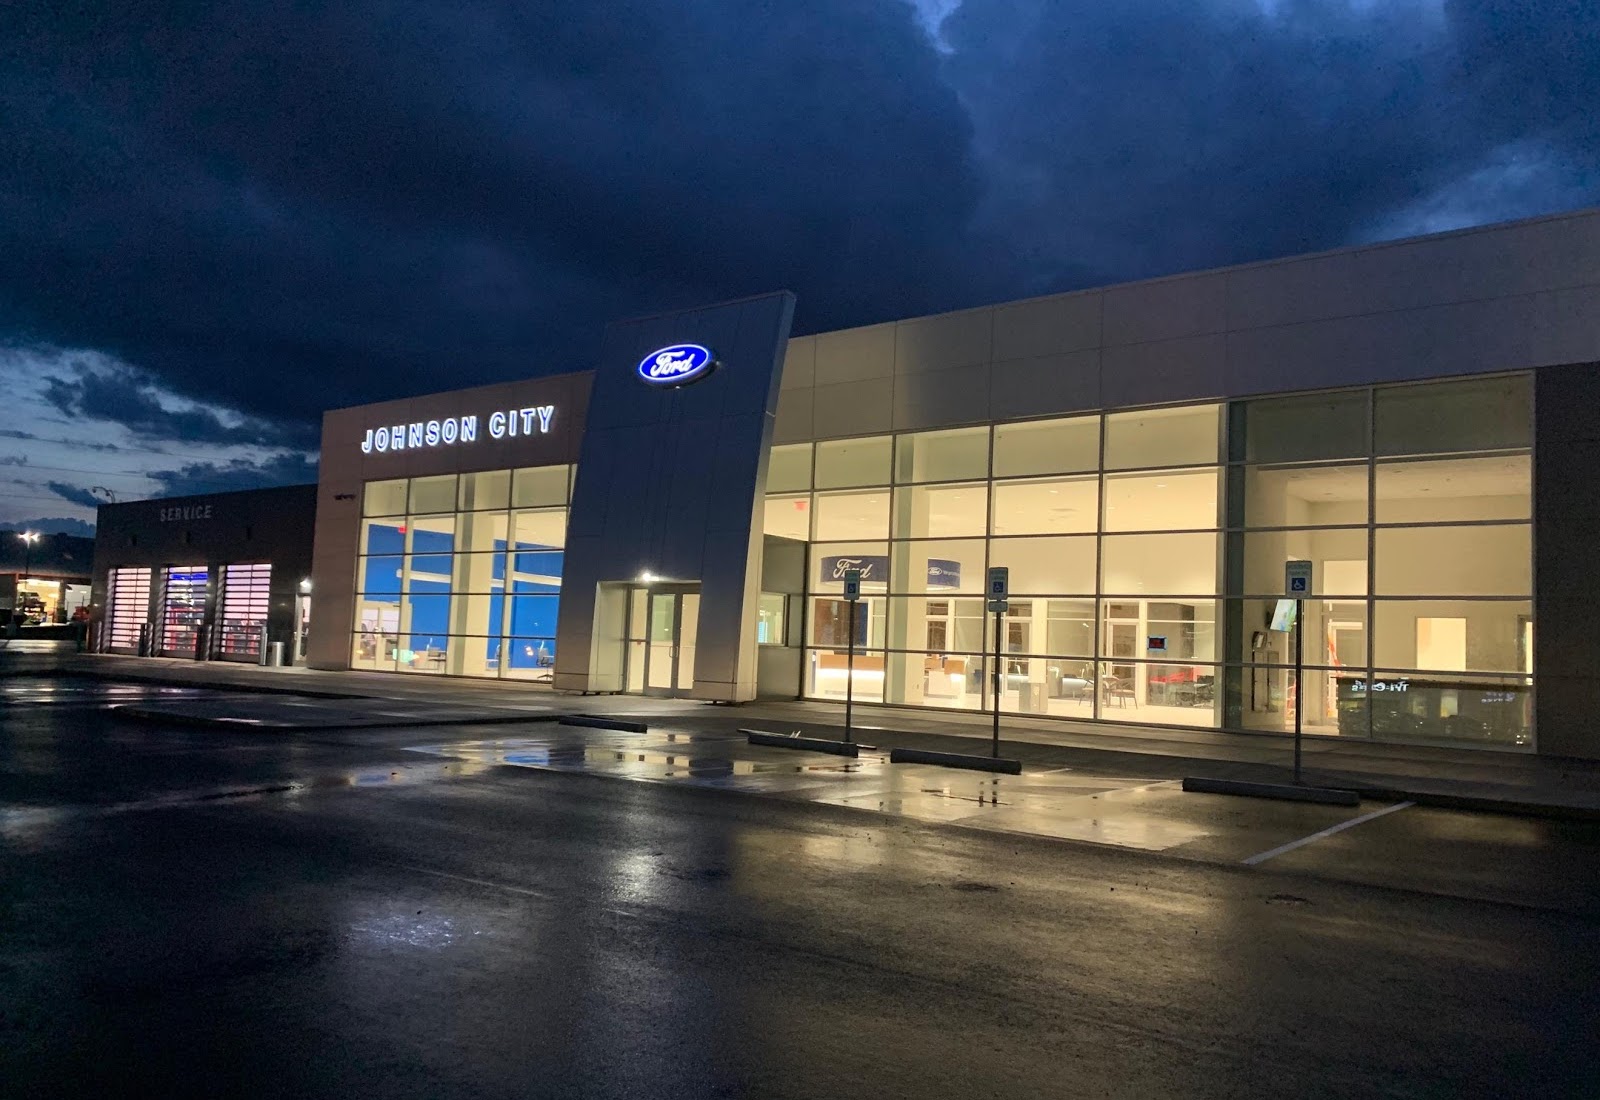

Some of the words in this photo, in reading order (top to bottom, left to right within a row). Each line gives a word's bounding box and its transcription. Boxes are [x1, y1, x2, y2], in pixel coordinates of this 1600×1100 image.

[649, 350, 695, 377] Ford
[361, 415, 478, 453] JOHNSON
[489, 405, 555, 438] CITY
[159, 504, 212, 522] SERVICE
